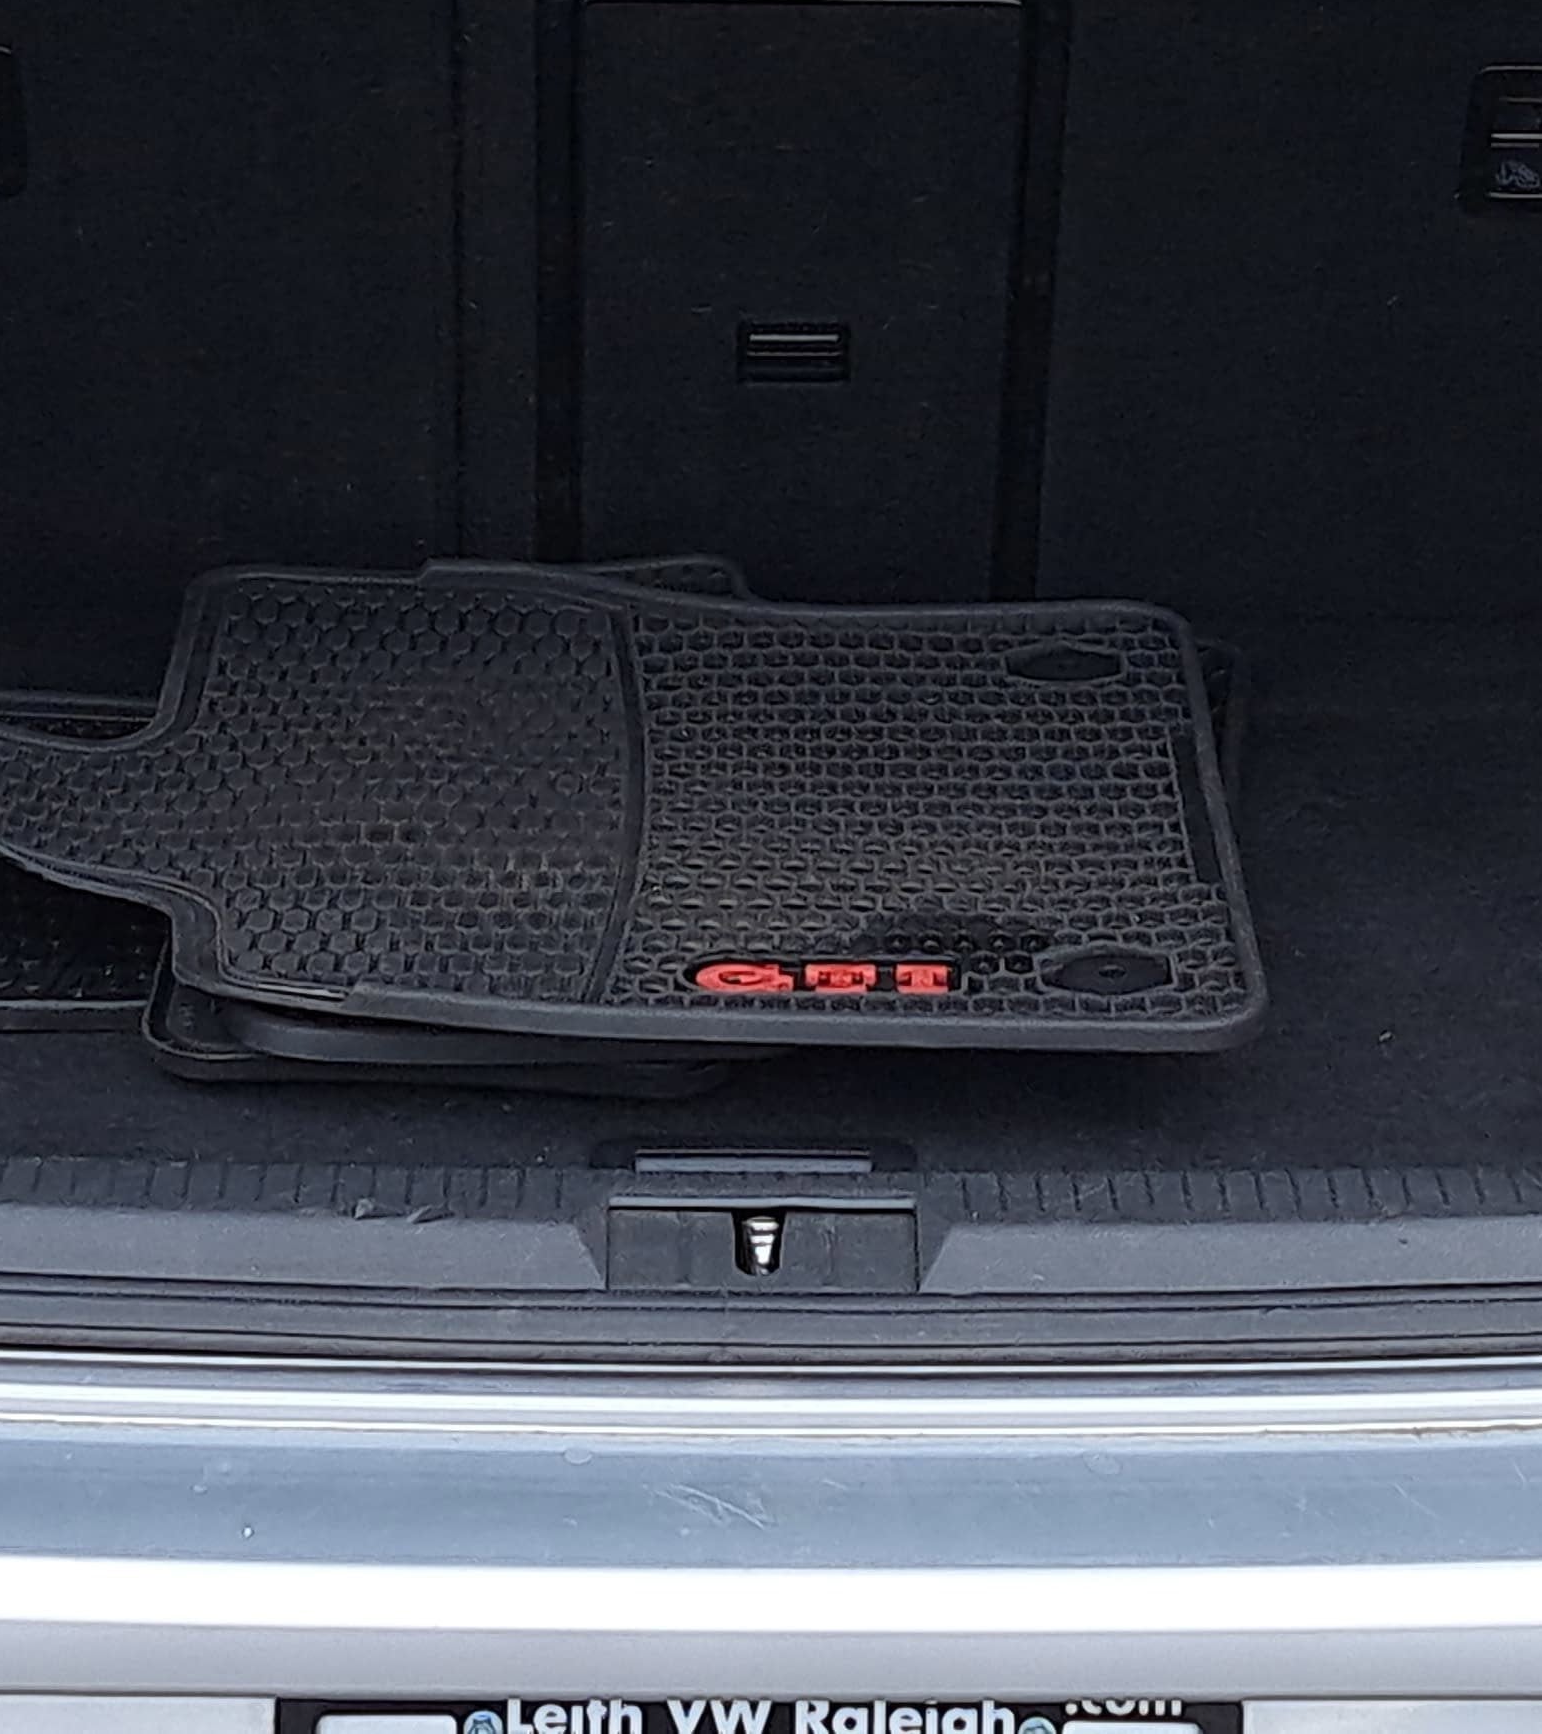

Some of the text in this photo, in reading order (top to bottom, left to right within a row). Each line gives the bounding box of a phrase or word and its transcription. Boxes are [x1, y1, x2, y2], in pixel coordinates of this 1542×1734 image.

[695, 963, 949, 994] GTI
[507, 1698, 643, 1734] Leith
[666, 1698, 772, 1734] VW
[795, 1698, 1016, 1734] Raleigh
